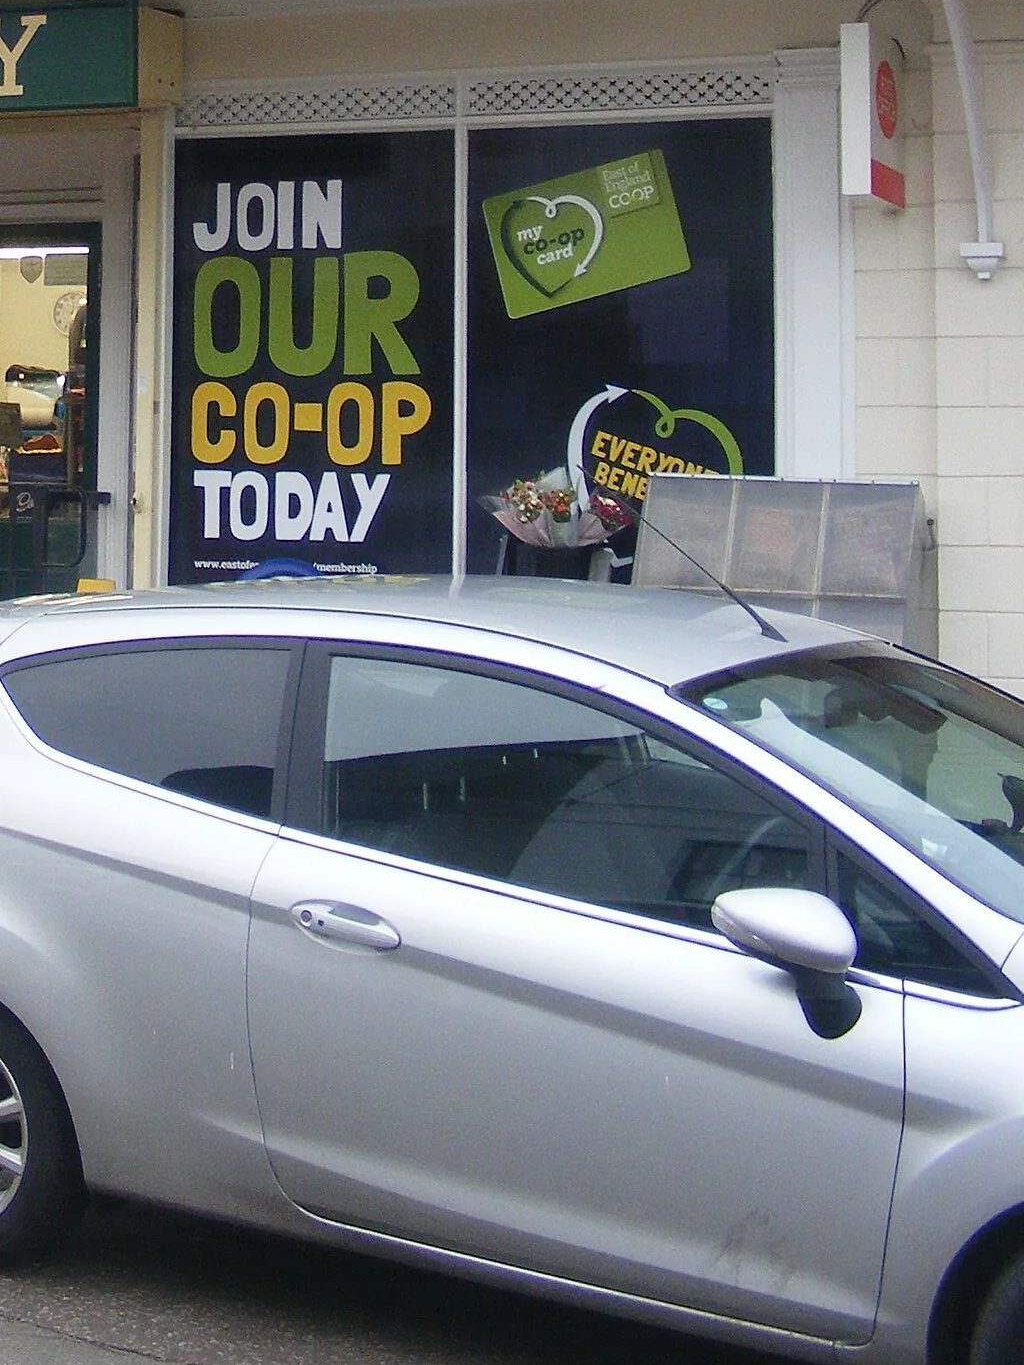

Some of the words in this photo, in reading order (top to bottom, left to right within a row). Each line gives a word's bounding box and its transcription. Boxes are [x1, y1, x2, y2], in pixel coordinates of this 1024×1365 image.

[605, 171, 652, 193] England
[193, 179, 343, 252] JOIN
[516, 224, 543, 242] my
[523, 227, 585, 255] co-op
[536, 241, 574, 265] card
[193, 249, 421, 378] OUR
[190, 380, 432, 466] CO-OP
[591, 430, 720, 475] EVERYON
[193, 470, 391, 542] TODAY
